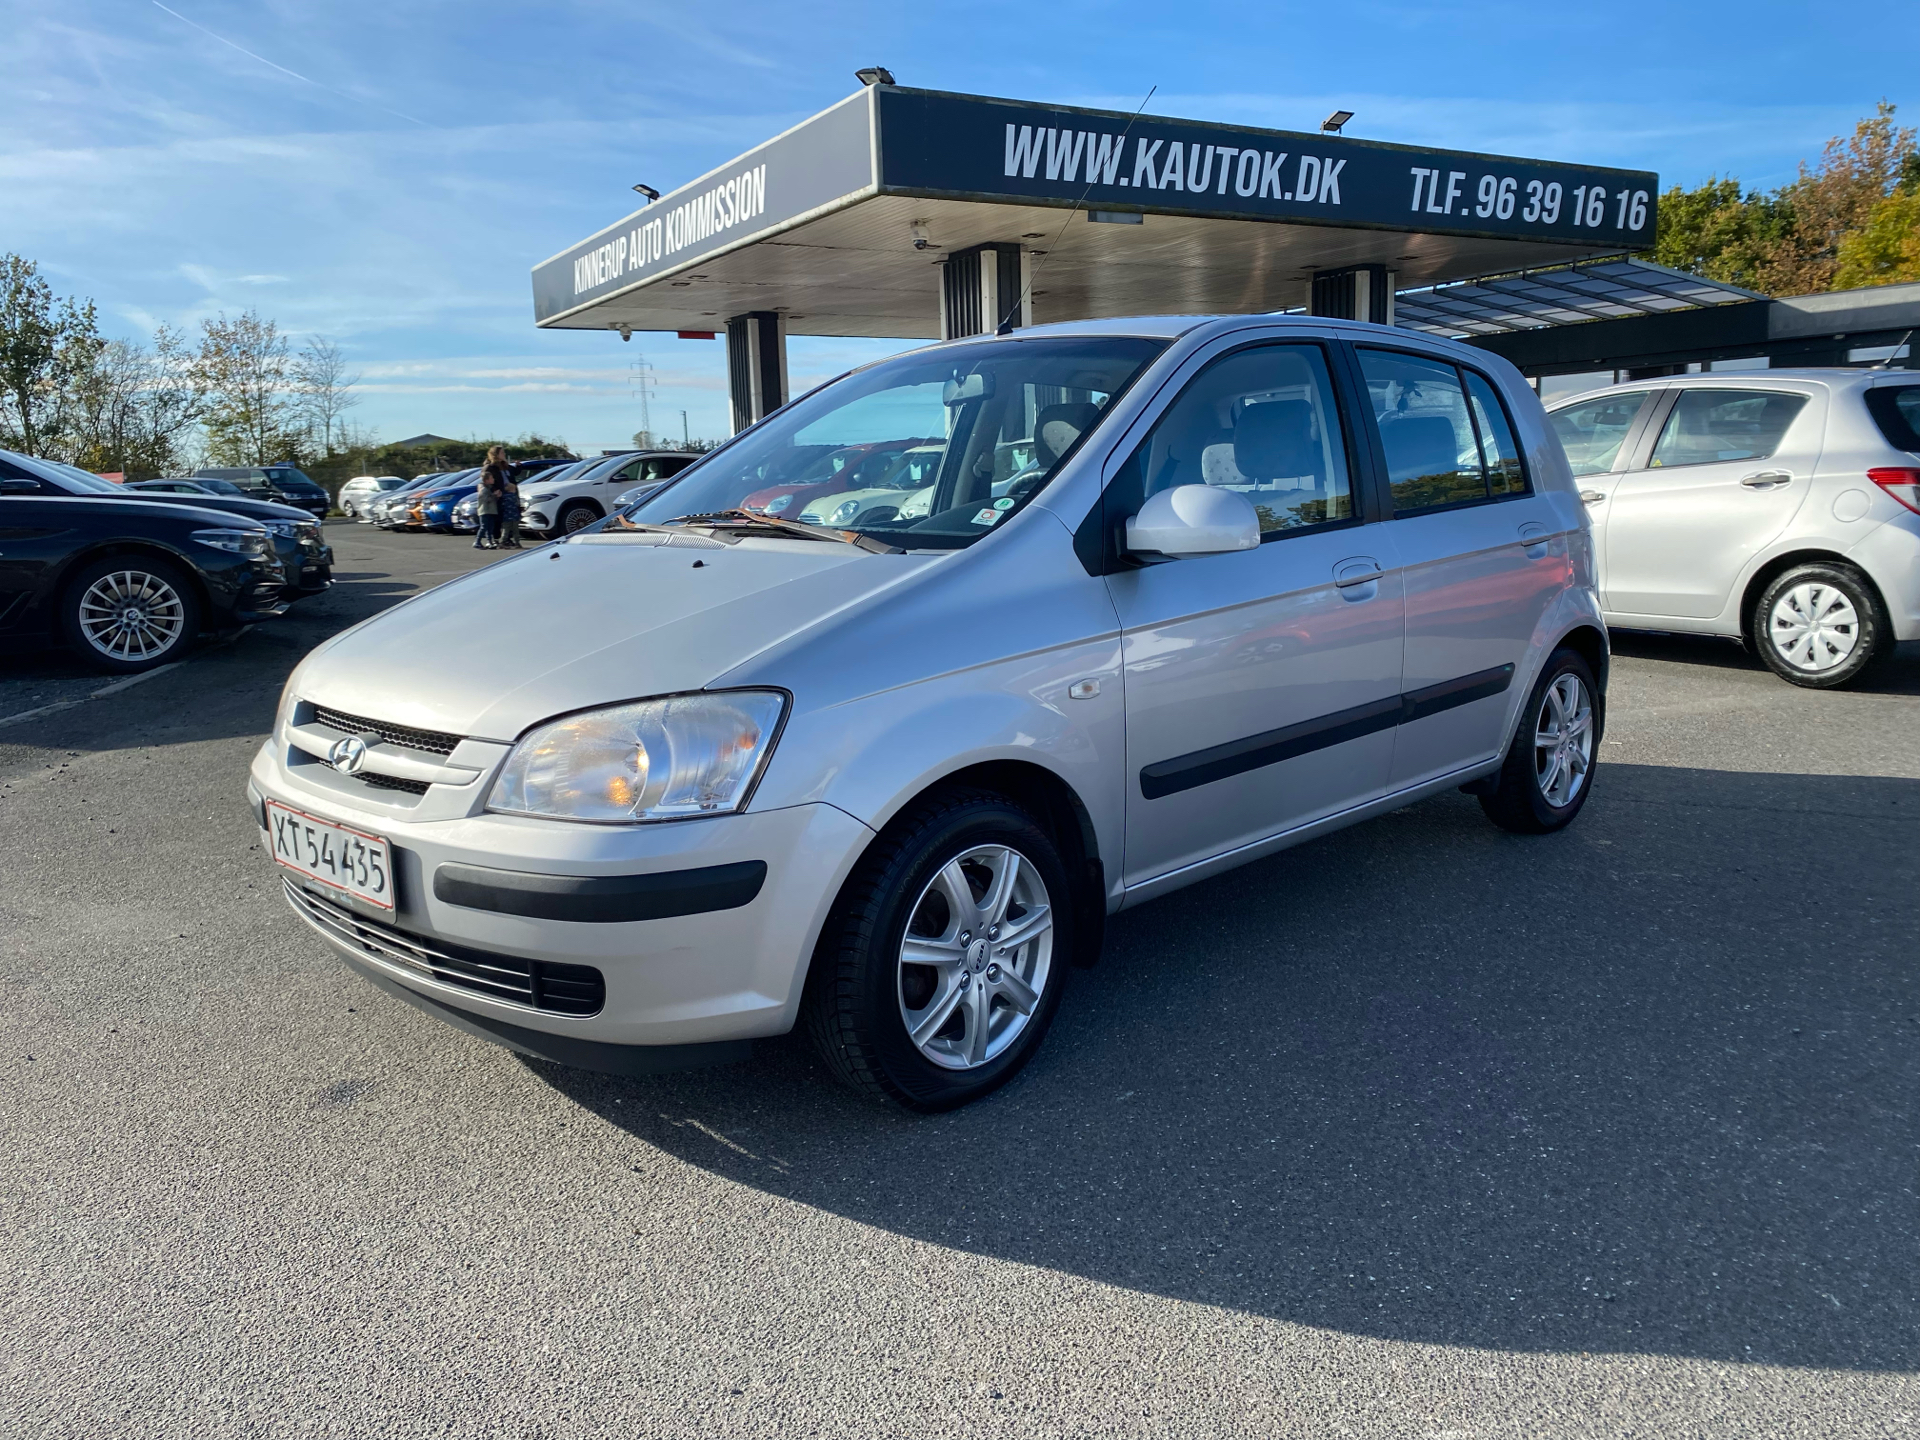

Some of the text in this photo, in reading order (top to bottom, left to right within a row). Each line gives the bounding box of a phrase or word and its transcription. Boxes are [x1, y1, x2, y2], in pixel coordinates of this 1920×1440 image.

[1004, 123, 1348, 205] WWW.KAUTOK.DK
[1410, 167, 1649, 231] TLF. 96 39 16 16
[574, 164, 767, 295] KINNERUP AUTO KOMMISSION
[273, 812, 300, 861] XT
[305, 826, 336, 875] 54
[342, 838, 385, 894] 435
